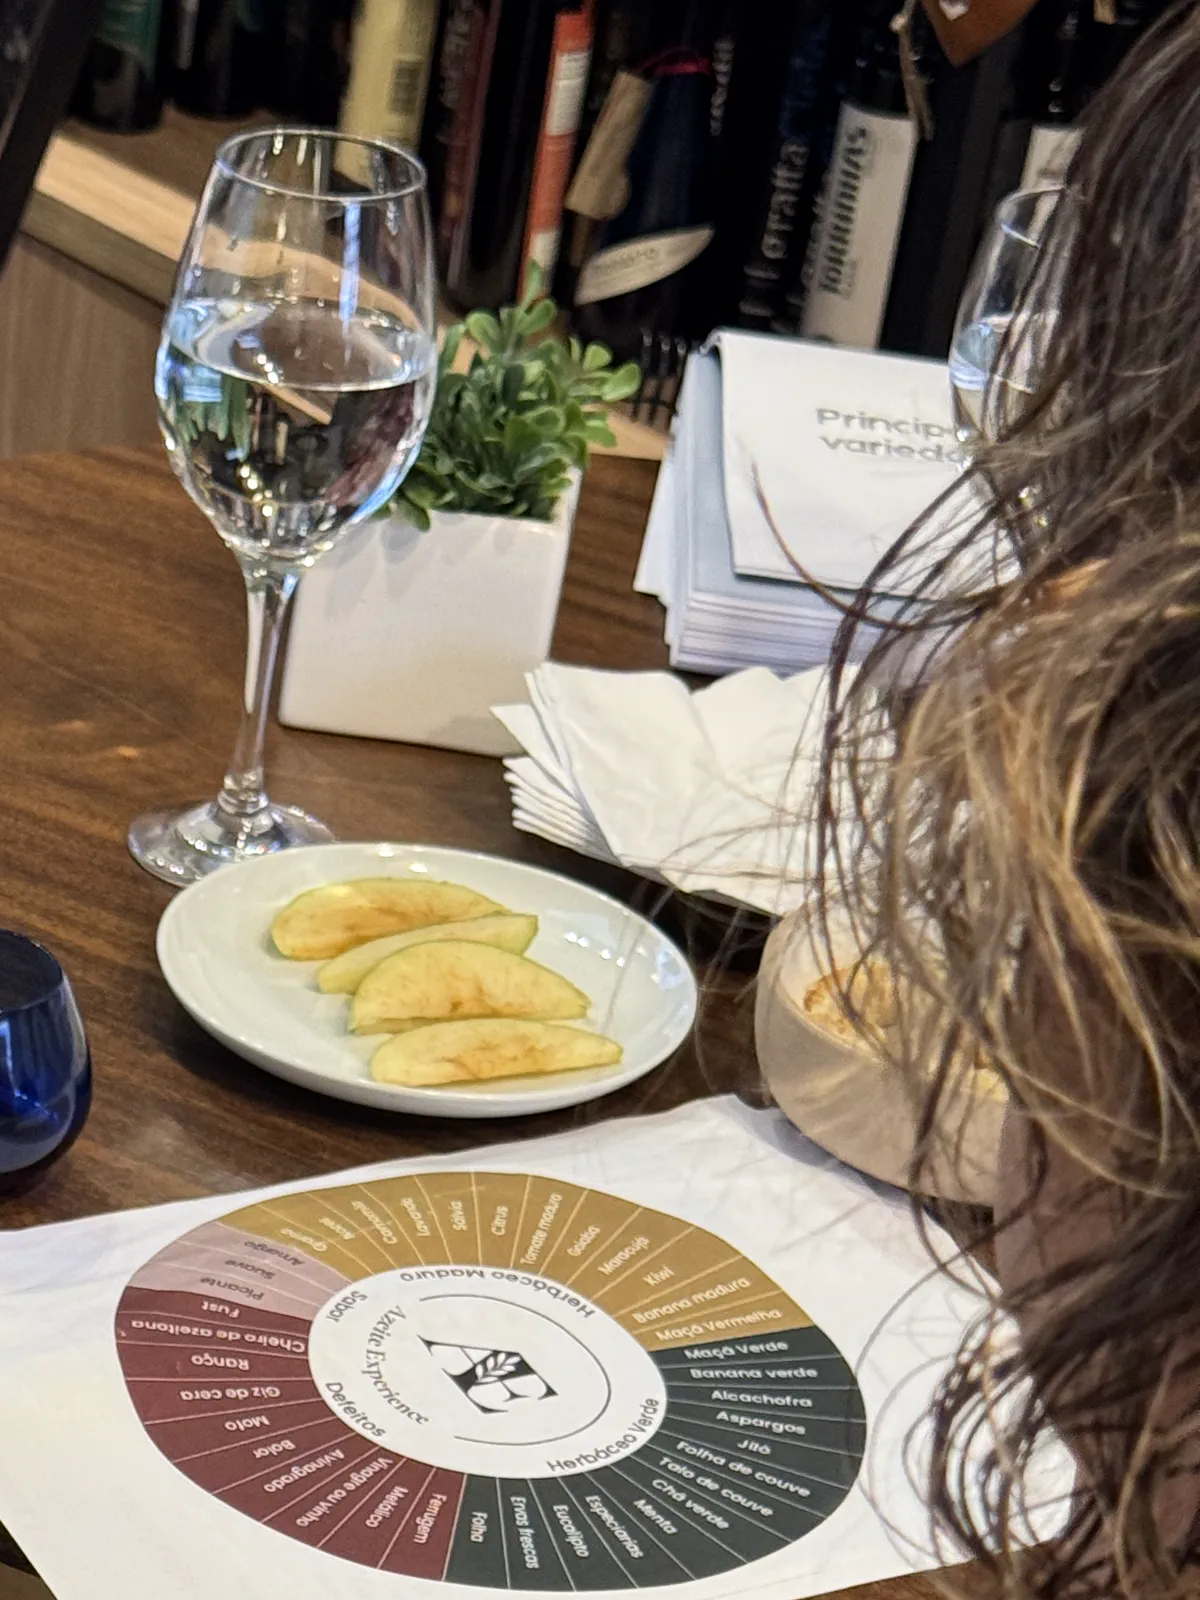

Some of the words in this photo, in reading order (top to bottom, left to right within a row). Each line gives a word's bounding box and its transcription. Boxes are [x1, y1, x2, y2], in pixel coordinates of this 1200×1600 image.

[816, 407, 956, 439] Princip
[491, 1205, 510, 1236] Citrus
[244, 1240, 307, 1266] Amargo
[520, 1229, 548, 1266] Tomate
[566, 1224, 601, 1257] Goiaba
[597, 1235, 651, 1277] Maracujá
[224, 1259, 276, 1280] Suave
[400, 1268, 485, 1282] Maduro
[642, 1264, 675, 1287] Kiwi
[200, 1276, 266, 1301] Picante
[491, 1269, 596, 1319] Herbáceo
[632, 1296, 692, 1325] Banana
[691, 1275, 752, 1306] madura
[201, 1301, 240, 1319] Fust
[326, 1290, 368, 1323] Sabor
[131, 1319, 213, 1338] azeitona
[216, 1330, 241, 1341] de
[368, 1304, 407, 1347] Azeite
[655, 1321, 703, 1343] Maçã
[702, 1307, 783, 1332] Vermelha
[244, 1334, 305, 1353] Cheiro
[683, 1345, 734, 1361] Maçã
[735, 1340, 789, 1355] Verde
[191, 1352, 250, 1371] Ranço
[689, 1368, 762, 1380] Banana
[764, 1366, 819, 1379] verde
[179, 1389, 223, 1401] cera
[224, 1387, 249, 1398] de
[253, 1386, 281, 1398] Giz
[361, 1347, 429, 1425] Experience
[711, 1390, 813, 1408] Alcachofra
[224, 1414, 270, 1433] Mofo
[325, 1381, 387, 1438] Defeitos
[715, 1411, 806, 1435] Aspargos
[253, 1439, 296, 1459] Bolor
[547, 1432, 637, 1473] Herbáceo
[632, 1397, 660, 1435] Verde
[736, 1439, 771, 1456] Jiló
[263, 1449, 345, 1493] Avinagrado
[343, 1457, 393, 1491] Vinagre
[676, 1440, 726, 1466] Folha
[728, 1461, 753, 1476] de
[754, 1471, 811, 1498] couve
[327, 1488, 348, 1505] ou
[659, 1456, 695, 1479] Talo
[696, 1475, 720, 1491] de
[721, 1487, 774, 1517] couve
[296, 1496, 333, 1527] vinho
[365, 1485, 408, 1529] Metálico
[413, 1492, 447, 1544] Ferrugem
[510, 1495, 528, 1530] Ervas
[632, 1499, 678, 1535] Menta
[652, 1478, 687, 1502] Chá
[685, 1499, 729, 1530] verde
[470, 1511, 488, 1543] Folha
[552, 1504, 590, 1558] Eucalipto
[585, 1494, 644, 1559] Especiarias
[517, 1528, 540, 1570] frescas
